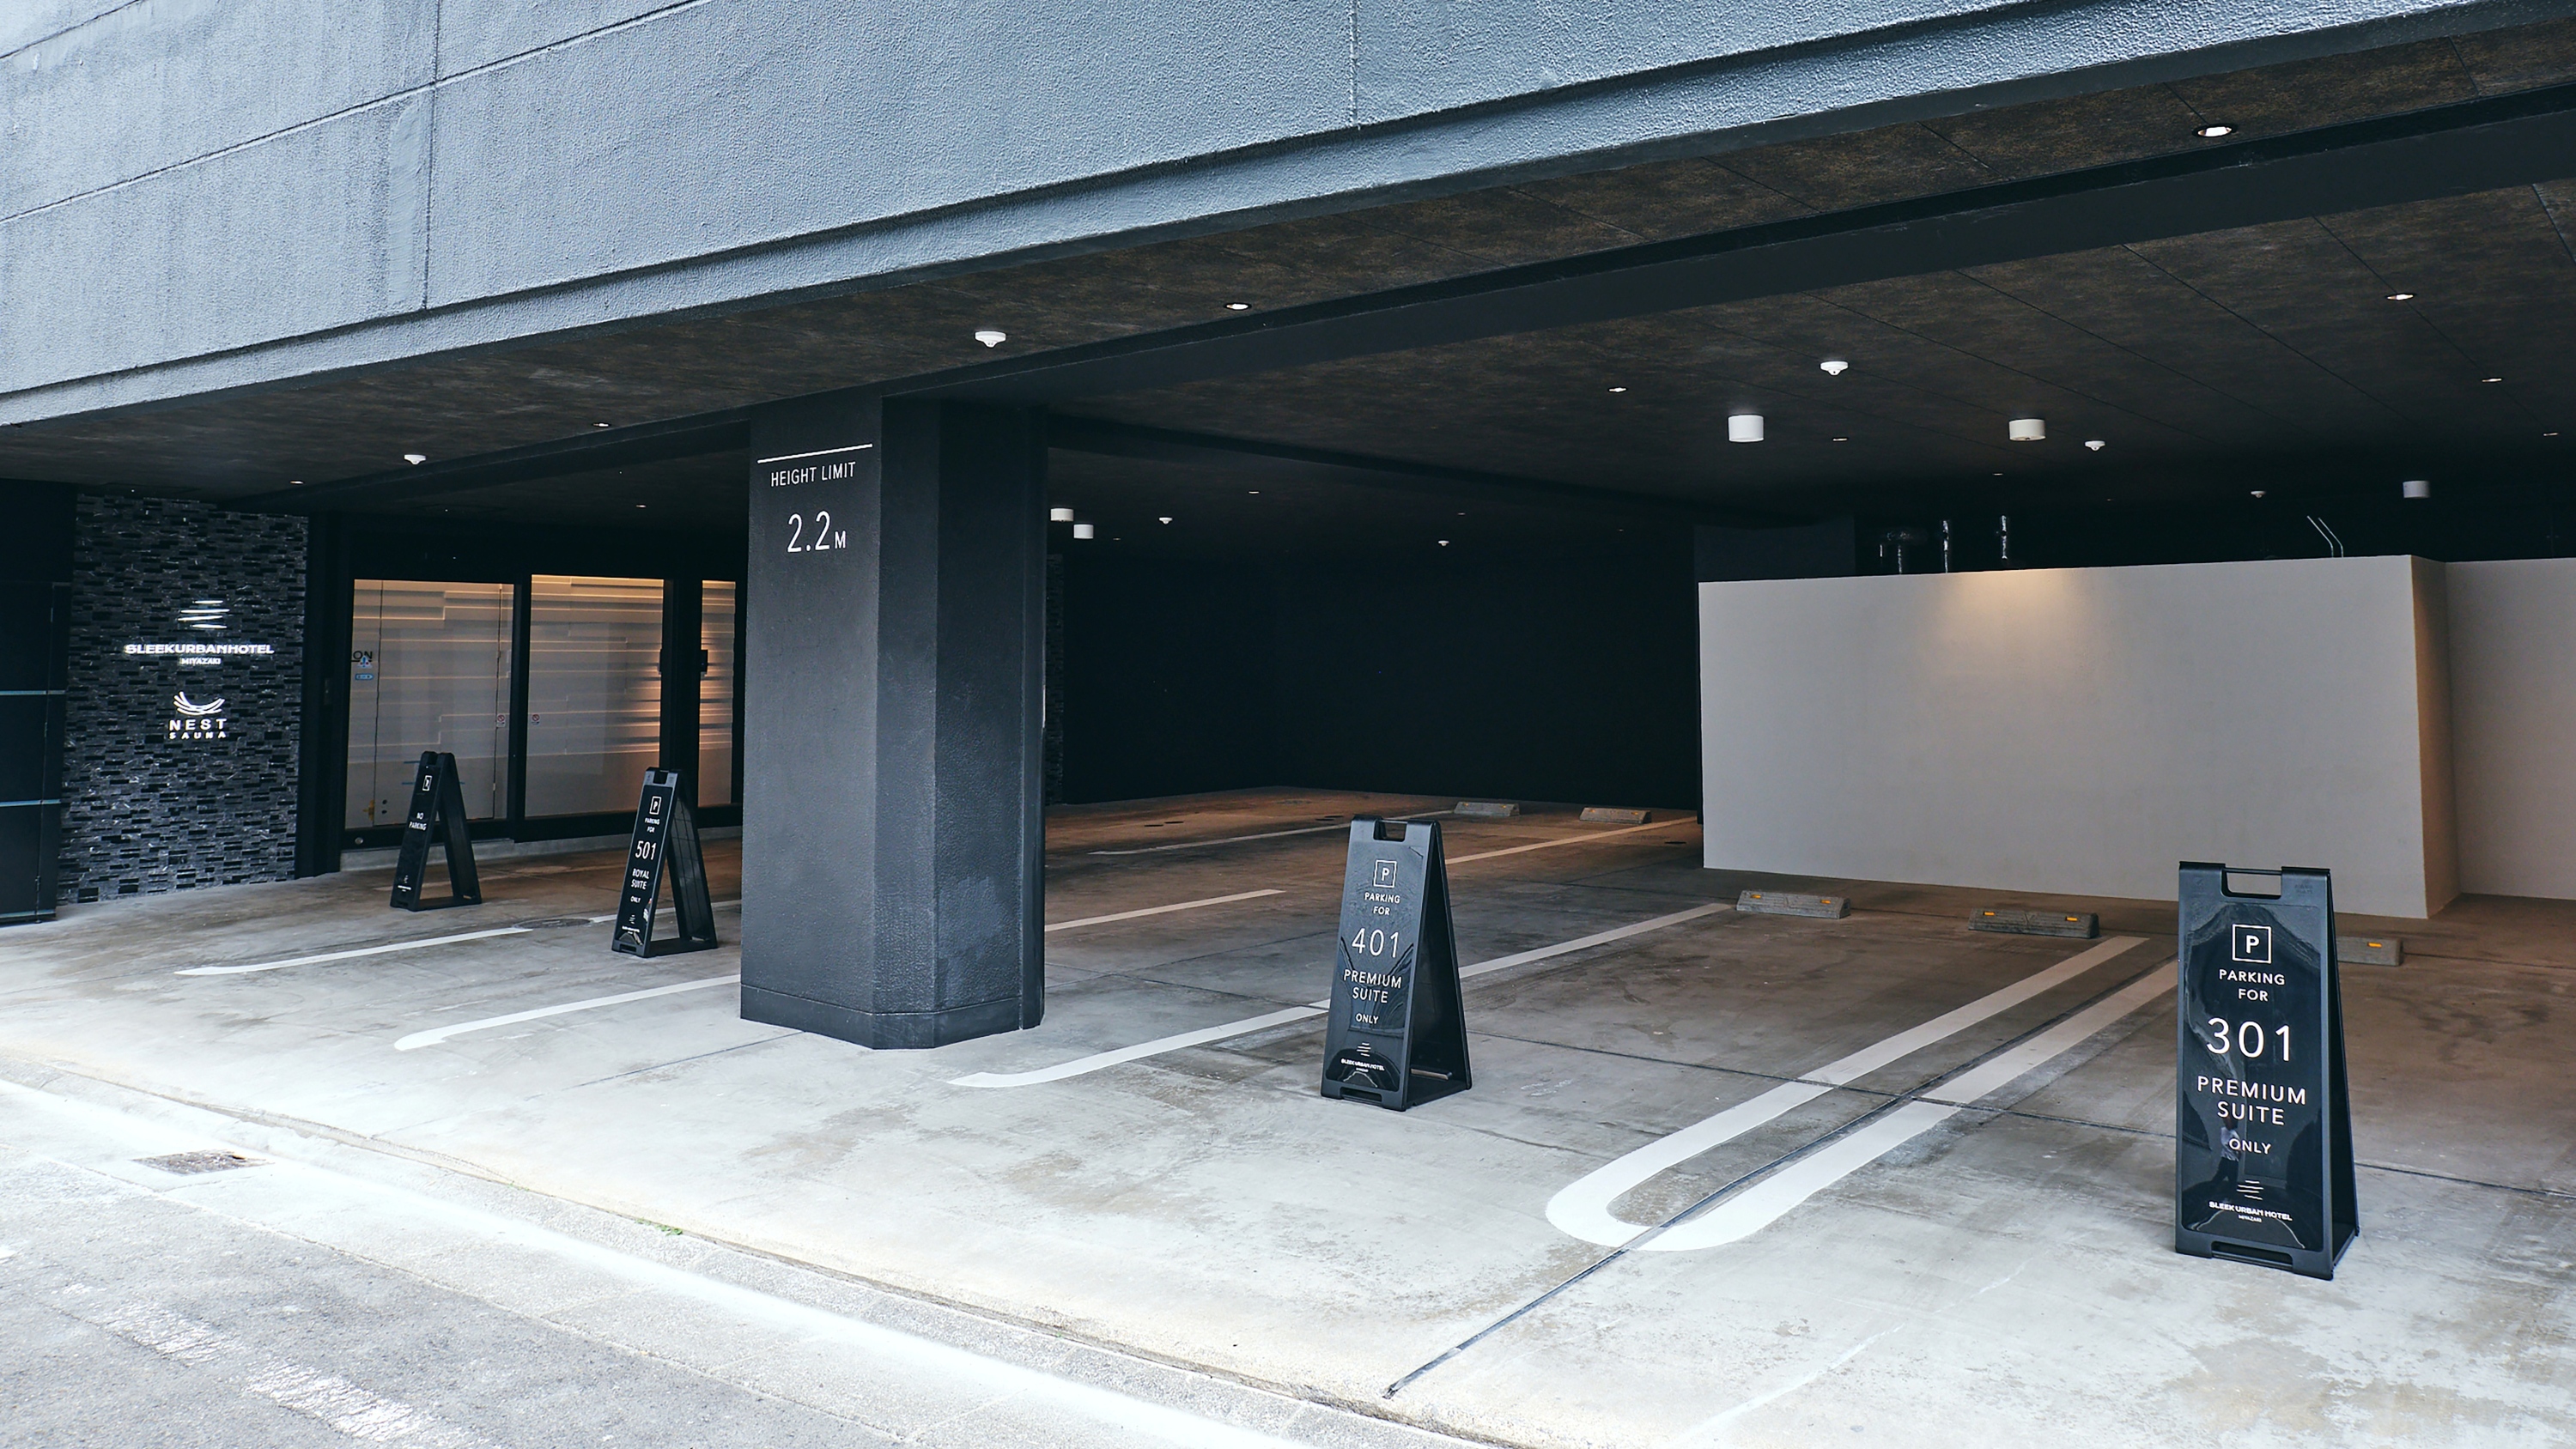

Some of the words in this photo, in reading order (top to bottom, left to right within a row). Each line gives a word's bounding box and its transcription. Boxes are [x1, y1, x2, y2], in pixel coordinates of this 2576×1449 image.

[772, 467, 817, 486] HEIGHT
[822, 462, 855, 480] LIMIT
[170, 718, 227, 731] NEST
[409, 822, 427, 831] PARKING
[635, 840, 657, 860] 501
[632, 868, 650, 879] ROYAL
[1382, 868, 1389, 881] P
[630, 879, 647, 889] SUITE
[1364, 892, 1400, 904] PARKING
[1373, 906, 1390, 916] FOR
[1352, 929, 1398, 957] 401
[2246, 936, 2259, 953] P
[1343, 969, 1402, 989] PREMIUM
[2220, 969, 2284, 985] PARKING
[1352, 987, 1388, 1003] SUITE
[2239, 989, 2268, 1001] FOR
[1355, 1013, 1379, 1024] ONLY
[2207, 1018, 2288, 1061] 301
[2197, 1076, 2306, 1105] PREMIUM
[2217, 1101, 2284, 1125] SUITE
[2229, 1138, 2271, 1155] ONLY
[2209, 1202, 2234, 1211] SLEEK
[2235, 1206, 2263, 1216] URBAN
[2265, 1210, 2293, 1221] HOTEL
